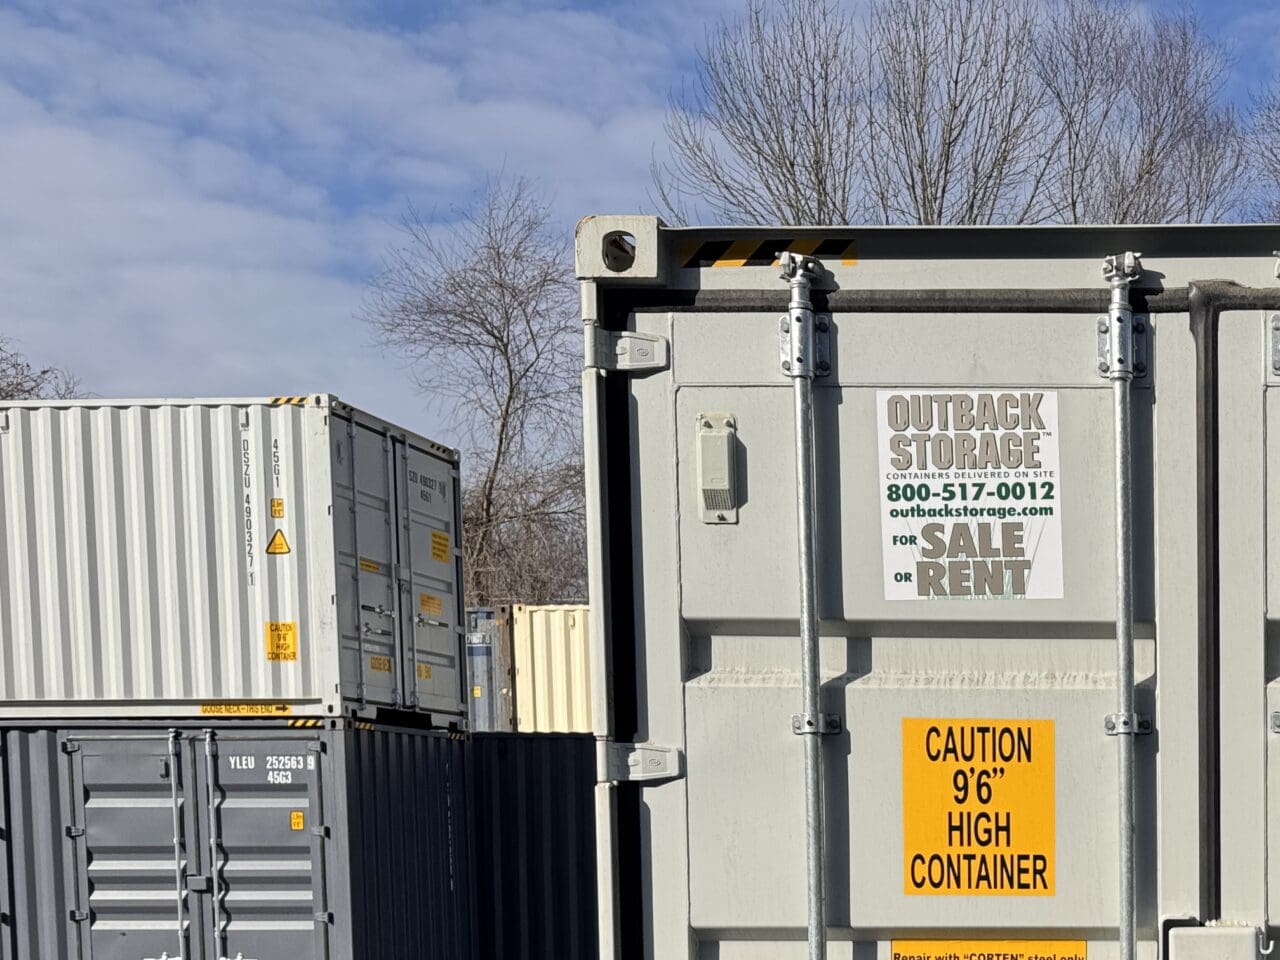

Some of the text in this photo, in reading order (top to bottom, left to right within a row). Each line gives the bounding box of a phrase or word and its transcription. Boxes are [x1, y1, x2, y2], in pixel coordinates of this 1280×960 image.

[887, 393, 1046, 432] OUTBACK
[889, 431, 1042, 471] STORAGE
[886, 470, 1055, 480] CONTAINERS DELIVERED ON SITE
[886, 481, 1055, 502] 800-517-0012
[889, 504, 1054, 519] outbackstorage.com
[892, 522, 1025, 559] FOR SALE
[894, 560, 1032, 597] OR RENT
[229, 755, 255, 769] YLEU
[266, 755, 304, 769] 252563
[925, 726, 1032, 763] CAUTION
[267, 771, 292, 784] 45G3
[947, 811, 1011, 847] HIGH
[910, 853, 1048, 890] CONTAINER
